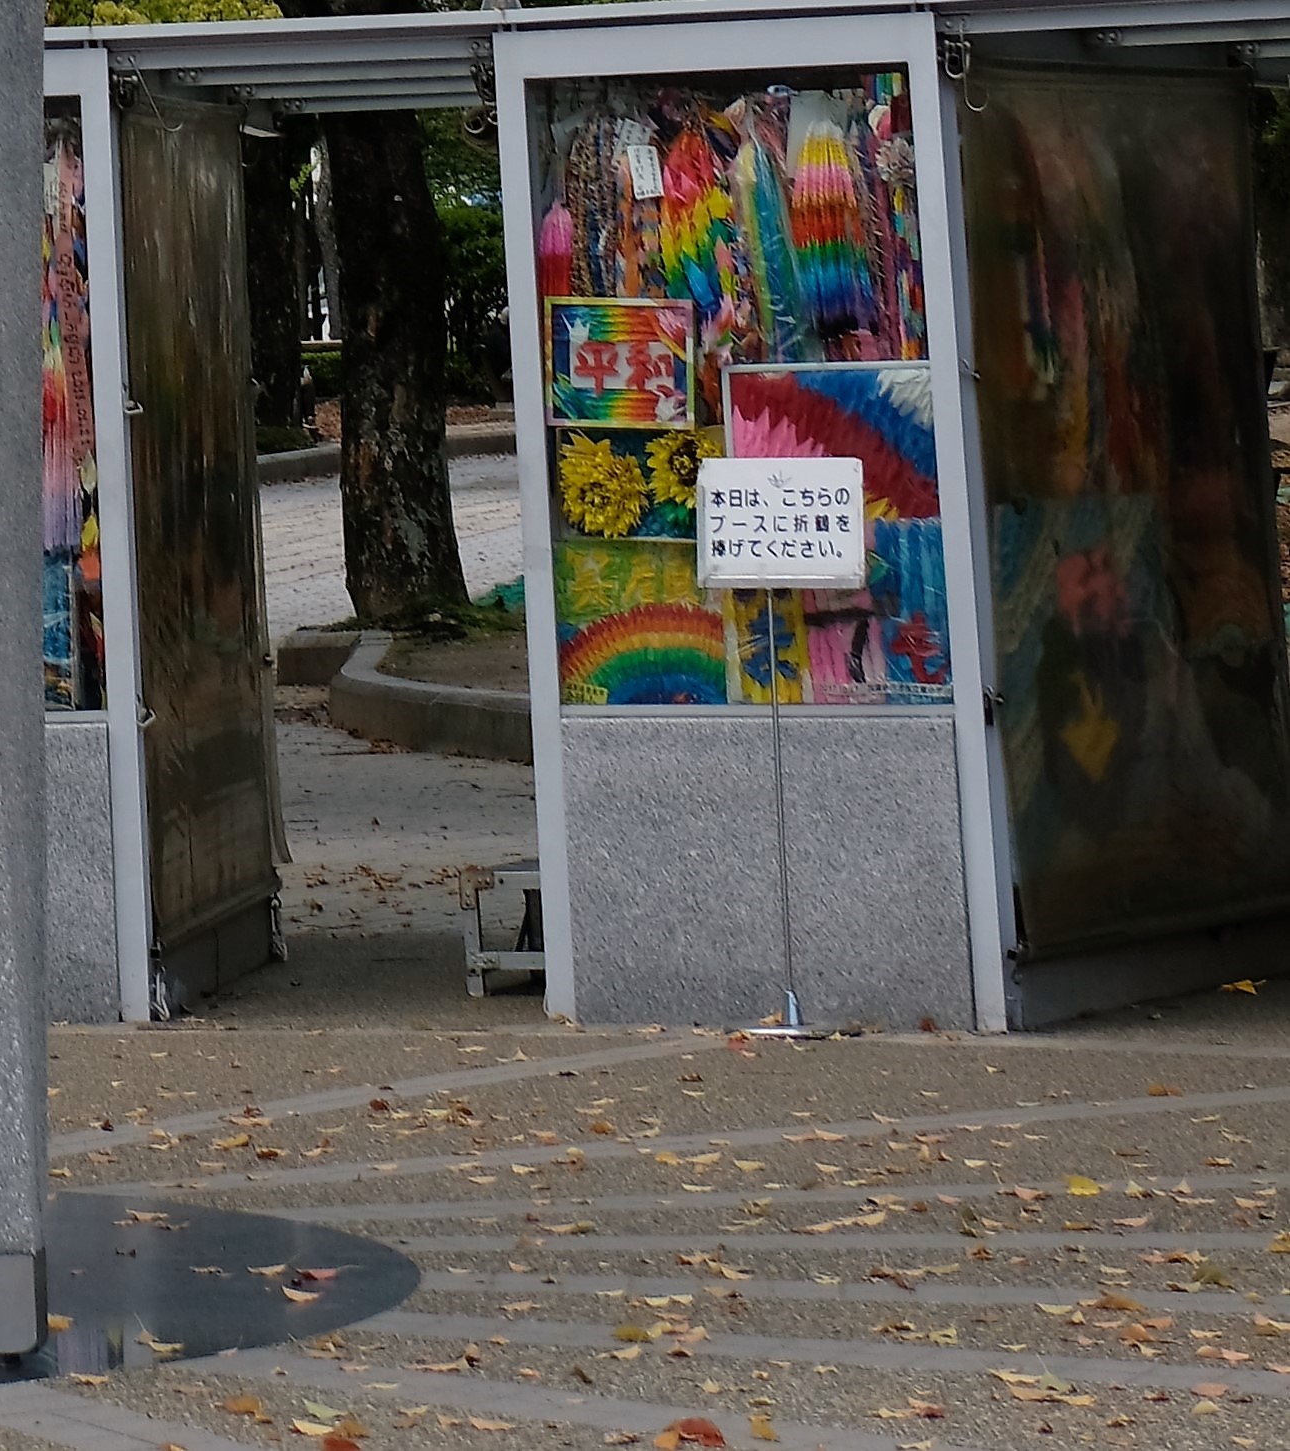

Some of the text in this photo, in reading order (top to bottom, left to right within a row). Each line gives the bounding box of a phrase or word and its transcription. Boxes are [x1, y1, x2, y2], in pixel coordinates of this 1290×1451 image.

[574, 341, 675, 397] 平和
[710, 488, 851, 508] 本日は、こちらの
[710, 514, 851, 534] ブースに折鶴を
[711, 539, 843, 559] 捧げてください。
